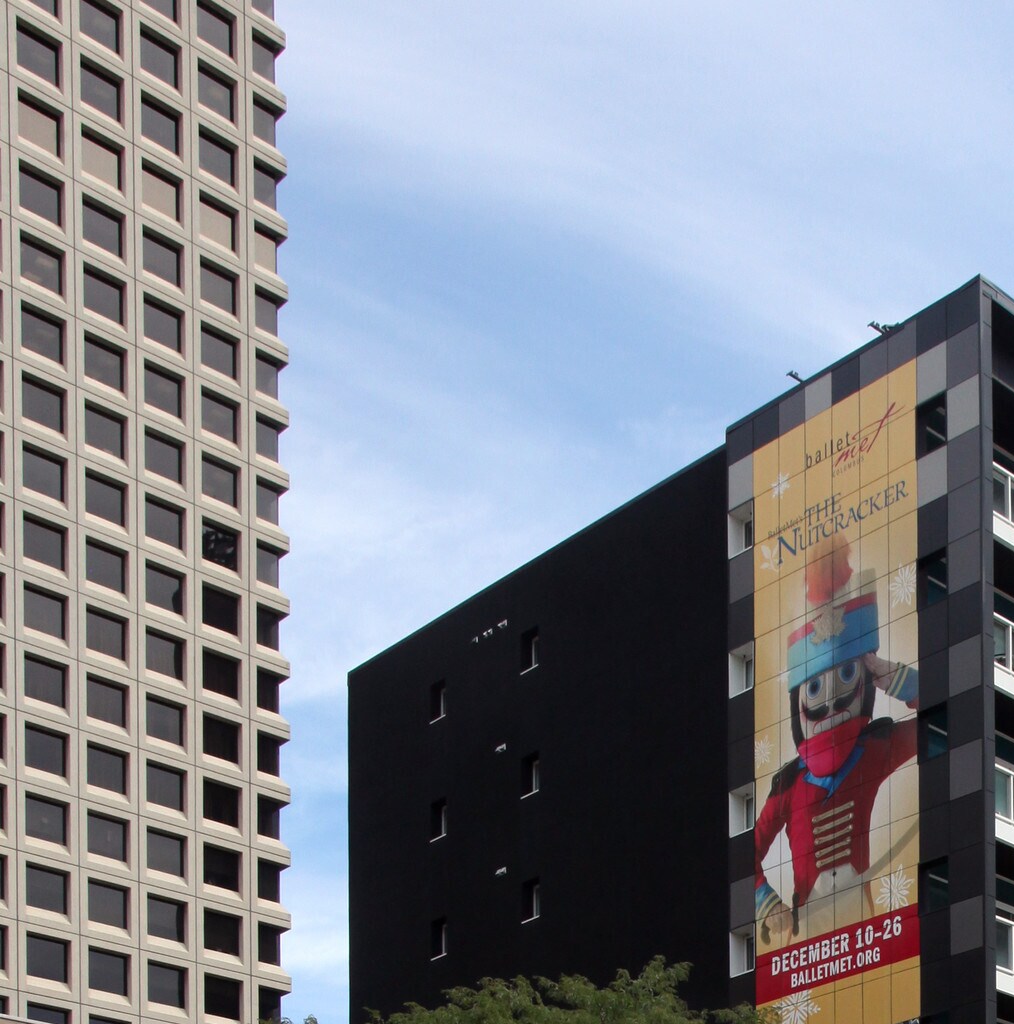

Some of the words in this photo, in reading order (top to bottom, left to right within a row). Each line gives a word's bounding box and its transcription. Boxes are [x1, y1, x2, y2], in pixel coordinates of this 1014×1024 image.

[805, 431, 852, 469] ballet
[777, 479, 910, 567] NUTCRACKER
[804, 492, 843, 527] THE
[771, 932, 850, 976] DECEMBER
[855, 915, 902, 950] 10-26
[790, 946, 881, 989] BALLETMET.ORG
